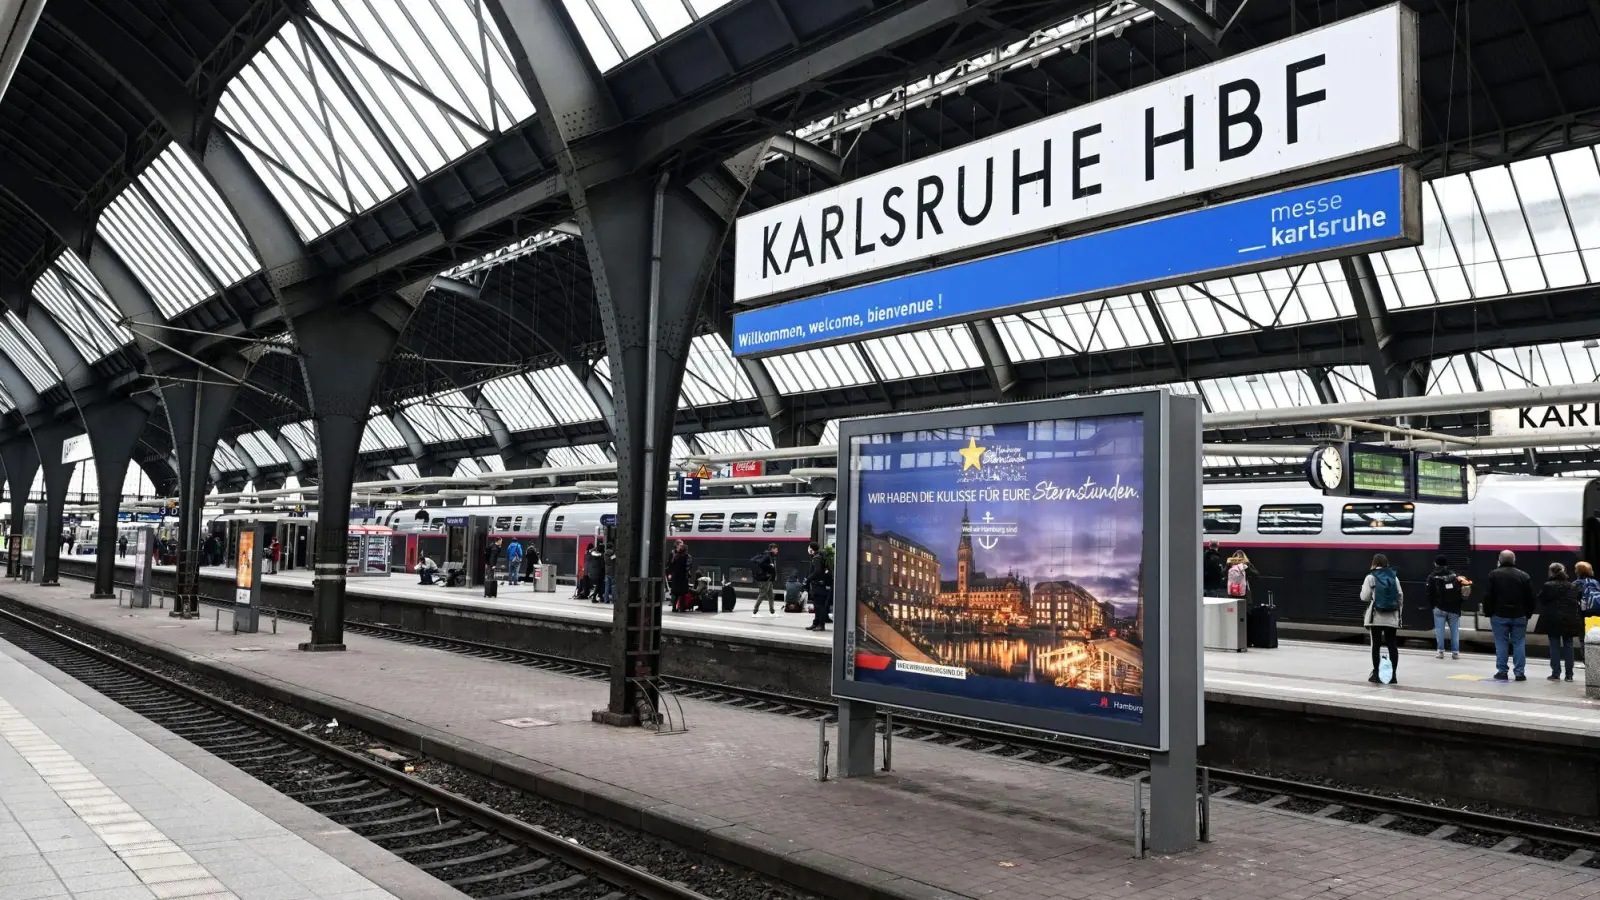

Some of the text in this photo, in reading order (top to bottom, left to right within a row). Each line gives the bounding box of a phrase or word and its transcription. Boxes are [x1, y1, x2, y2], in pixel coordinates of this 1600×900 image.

[762, 53, 1327, 279] KARLSRUHE HBF
[1271, 194, 1342, 223] messe
[1271, 209, 1387, 247] karlsruhe
[738, 323, 806, 348] Willkommen,
[808, 312, 864, 335] welcome,
[867, 299, 934, 323] bienvenue
[683, 478, 693, 495] E
[868, 474, 1139, 504] WIR HABEN DIE KULISSE FÜR EURE Sternstunden.
[981, 526, 1006, 534] Hamburg
[897, 662, 964, 677] WEILWIRHAMBURGSIND.DE
[1113, 701, 1144, 714] Hamburg
